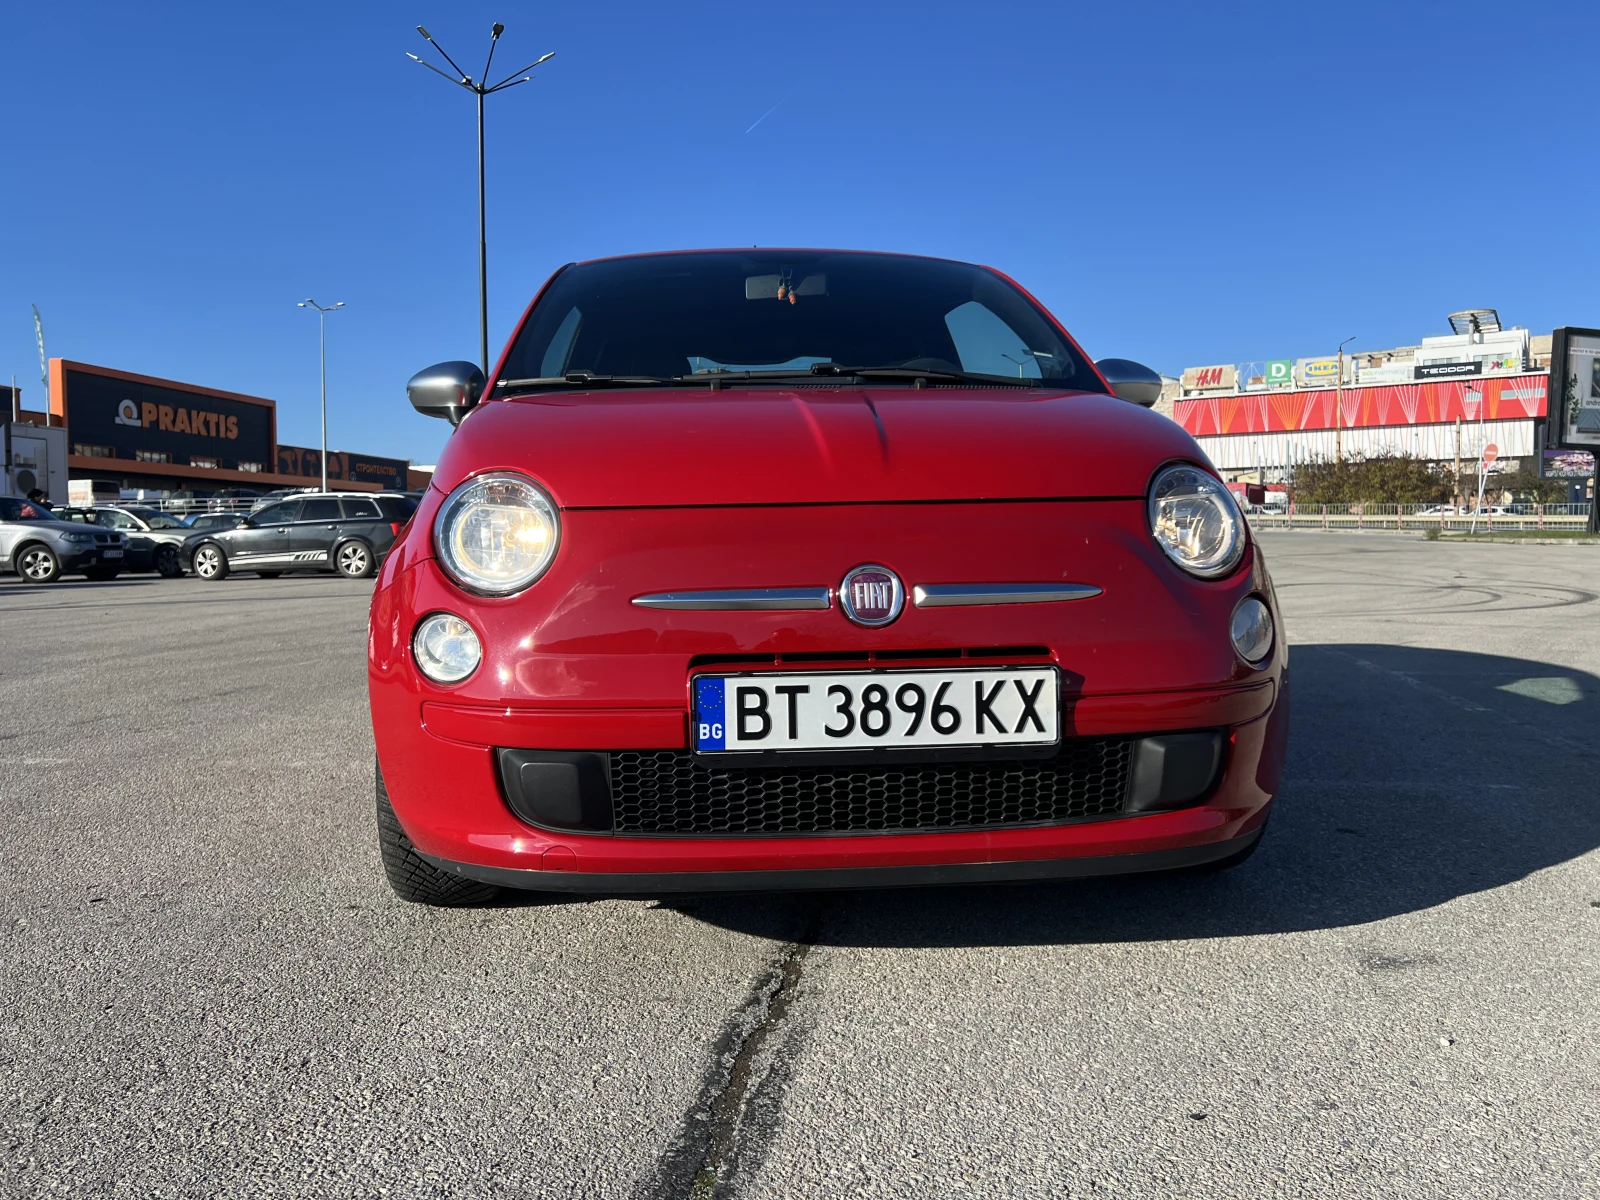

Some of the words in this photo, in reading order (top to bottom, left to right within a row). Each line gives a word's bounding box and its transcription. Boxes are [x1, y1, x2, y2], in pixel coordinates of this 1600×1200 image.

[1271, 363, 1286, 377] D
[1308, 364, 1339, 372] IKEA
[1421, 365, 1475, 375] TEODOR
[1196, 367, 1223, 387] H&M
[141, 401, 239, 440] PRAKTIS
[355, 462, 397, 476] СТРОИТЕЛСТВО
[855, 582, 890, 609] FIAT
[736, 685, 810, 740] BT
[824, 681, 961, 738] 3896
[975, 679, 1047, 734] KX
[699, 723, 722, 740] BG
